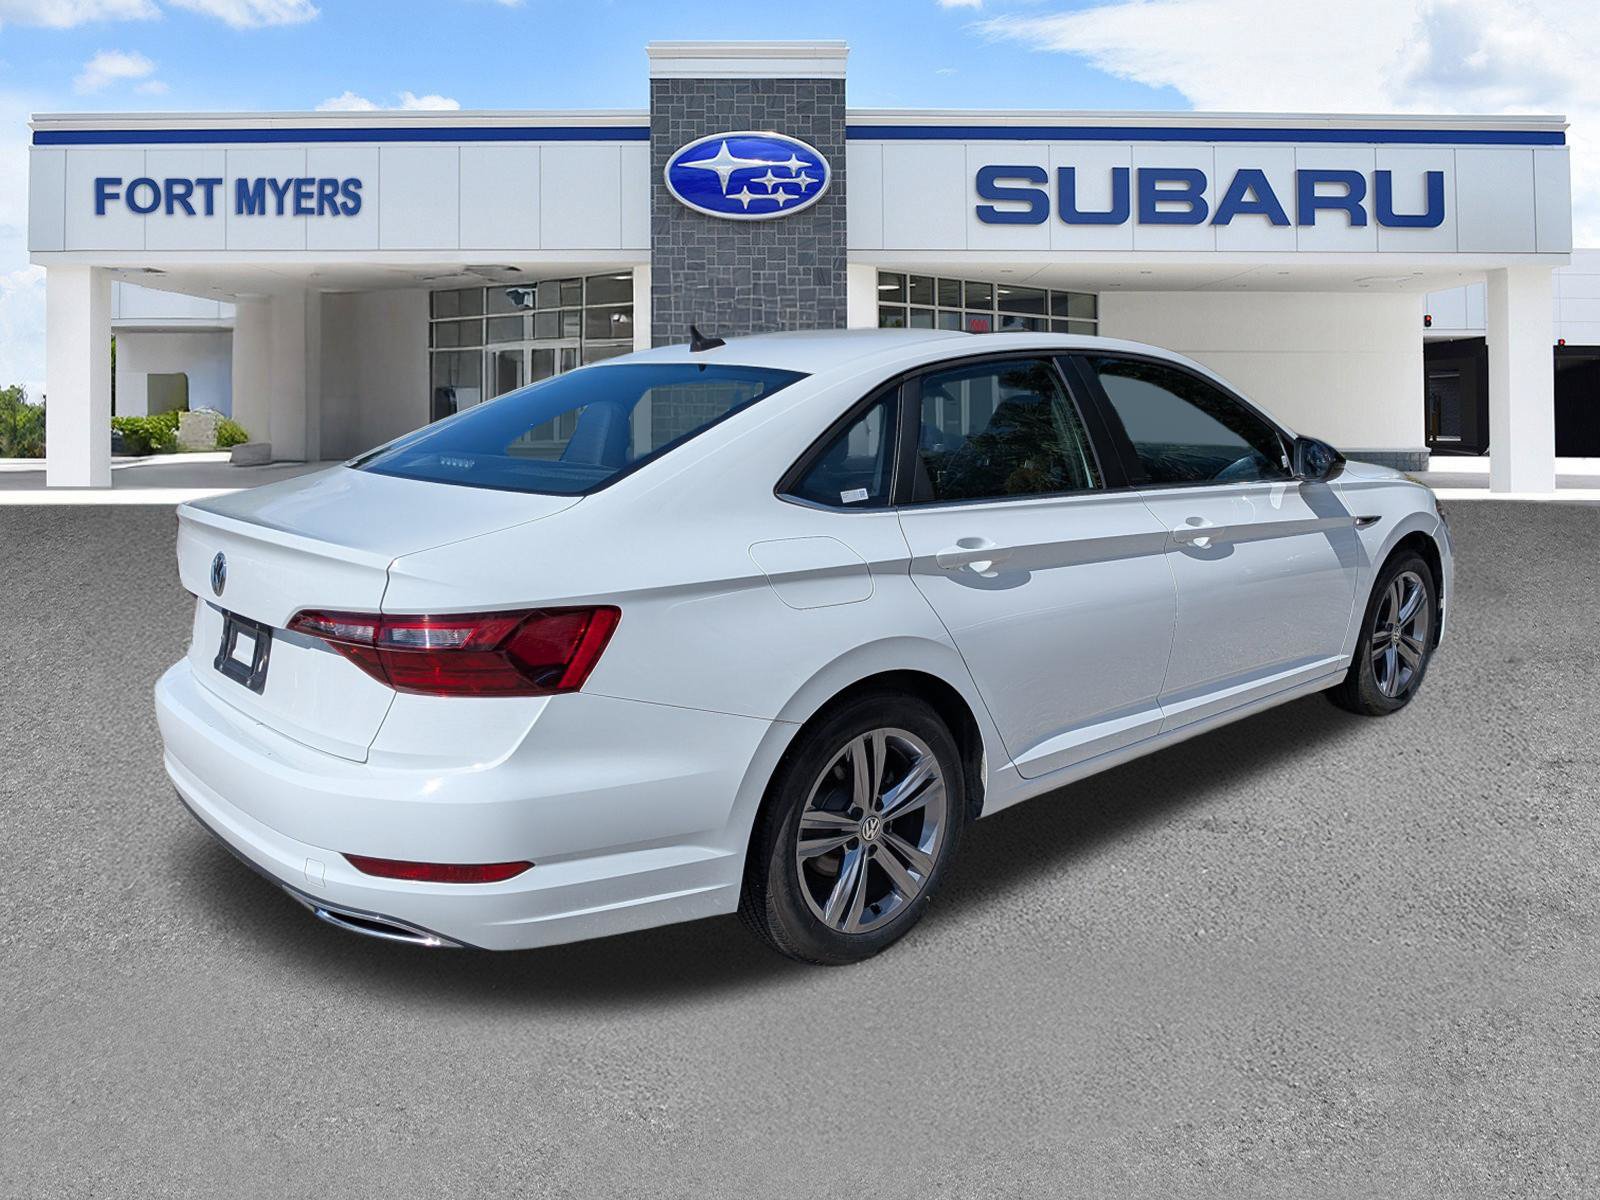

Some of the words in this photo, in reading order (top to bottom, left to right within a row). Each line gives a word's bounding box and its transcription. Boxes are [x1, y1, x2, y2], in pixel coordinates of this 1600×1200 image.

[94, 177, 223, 217] FORT
[235, 177, 363, 217] MYERS
[976, 165, 1445, 229] SUBARU
